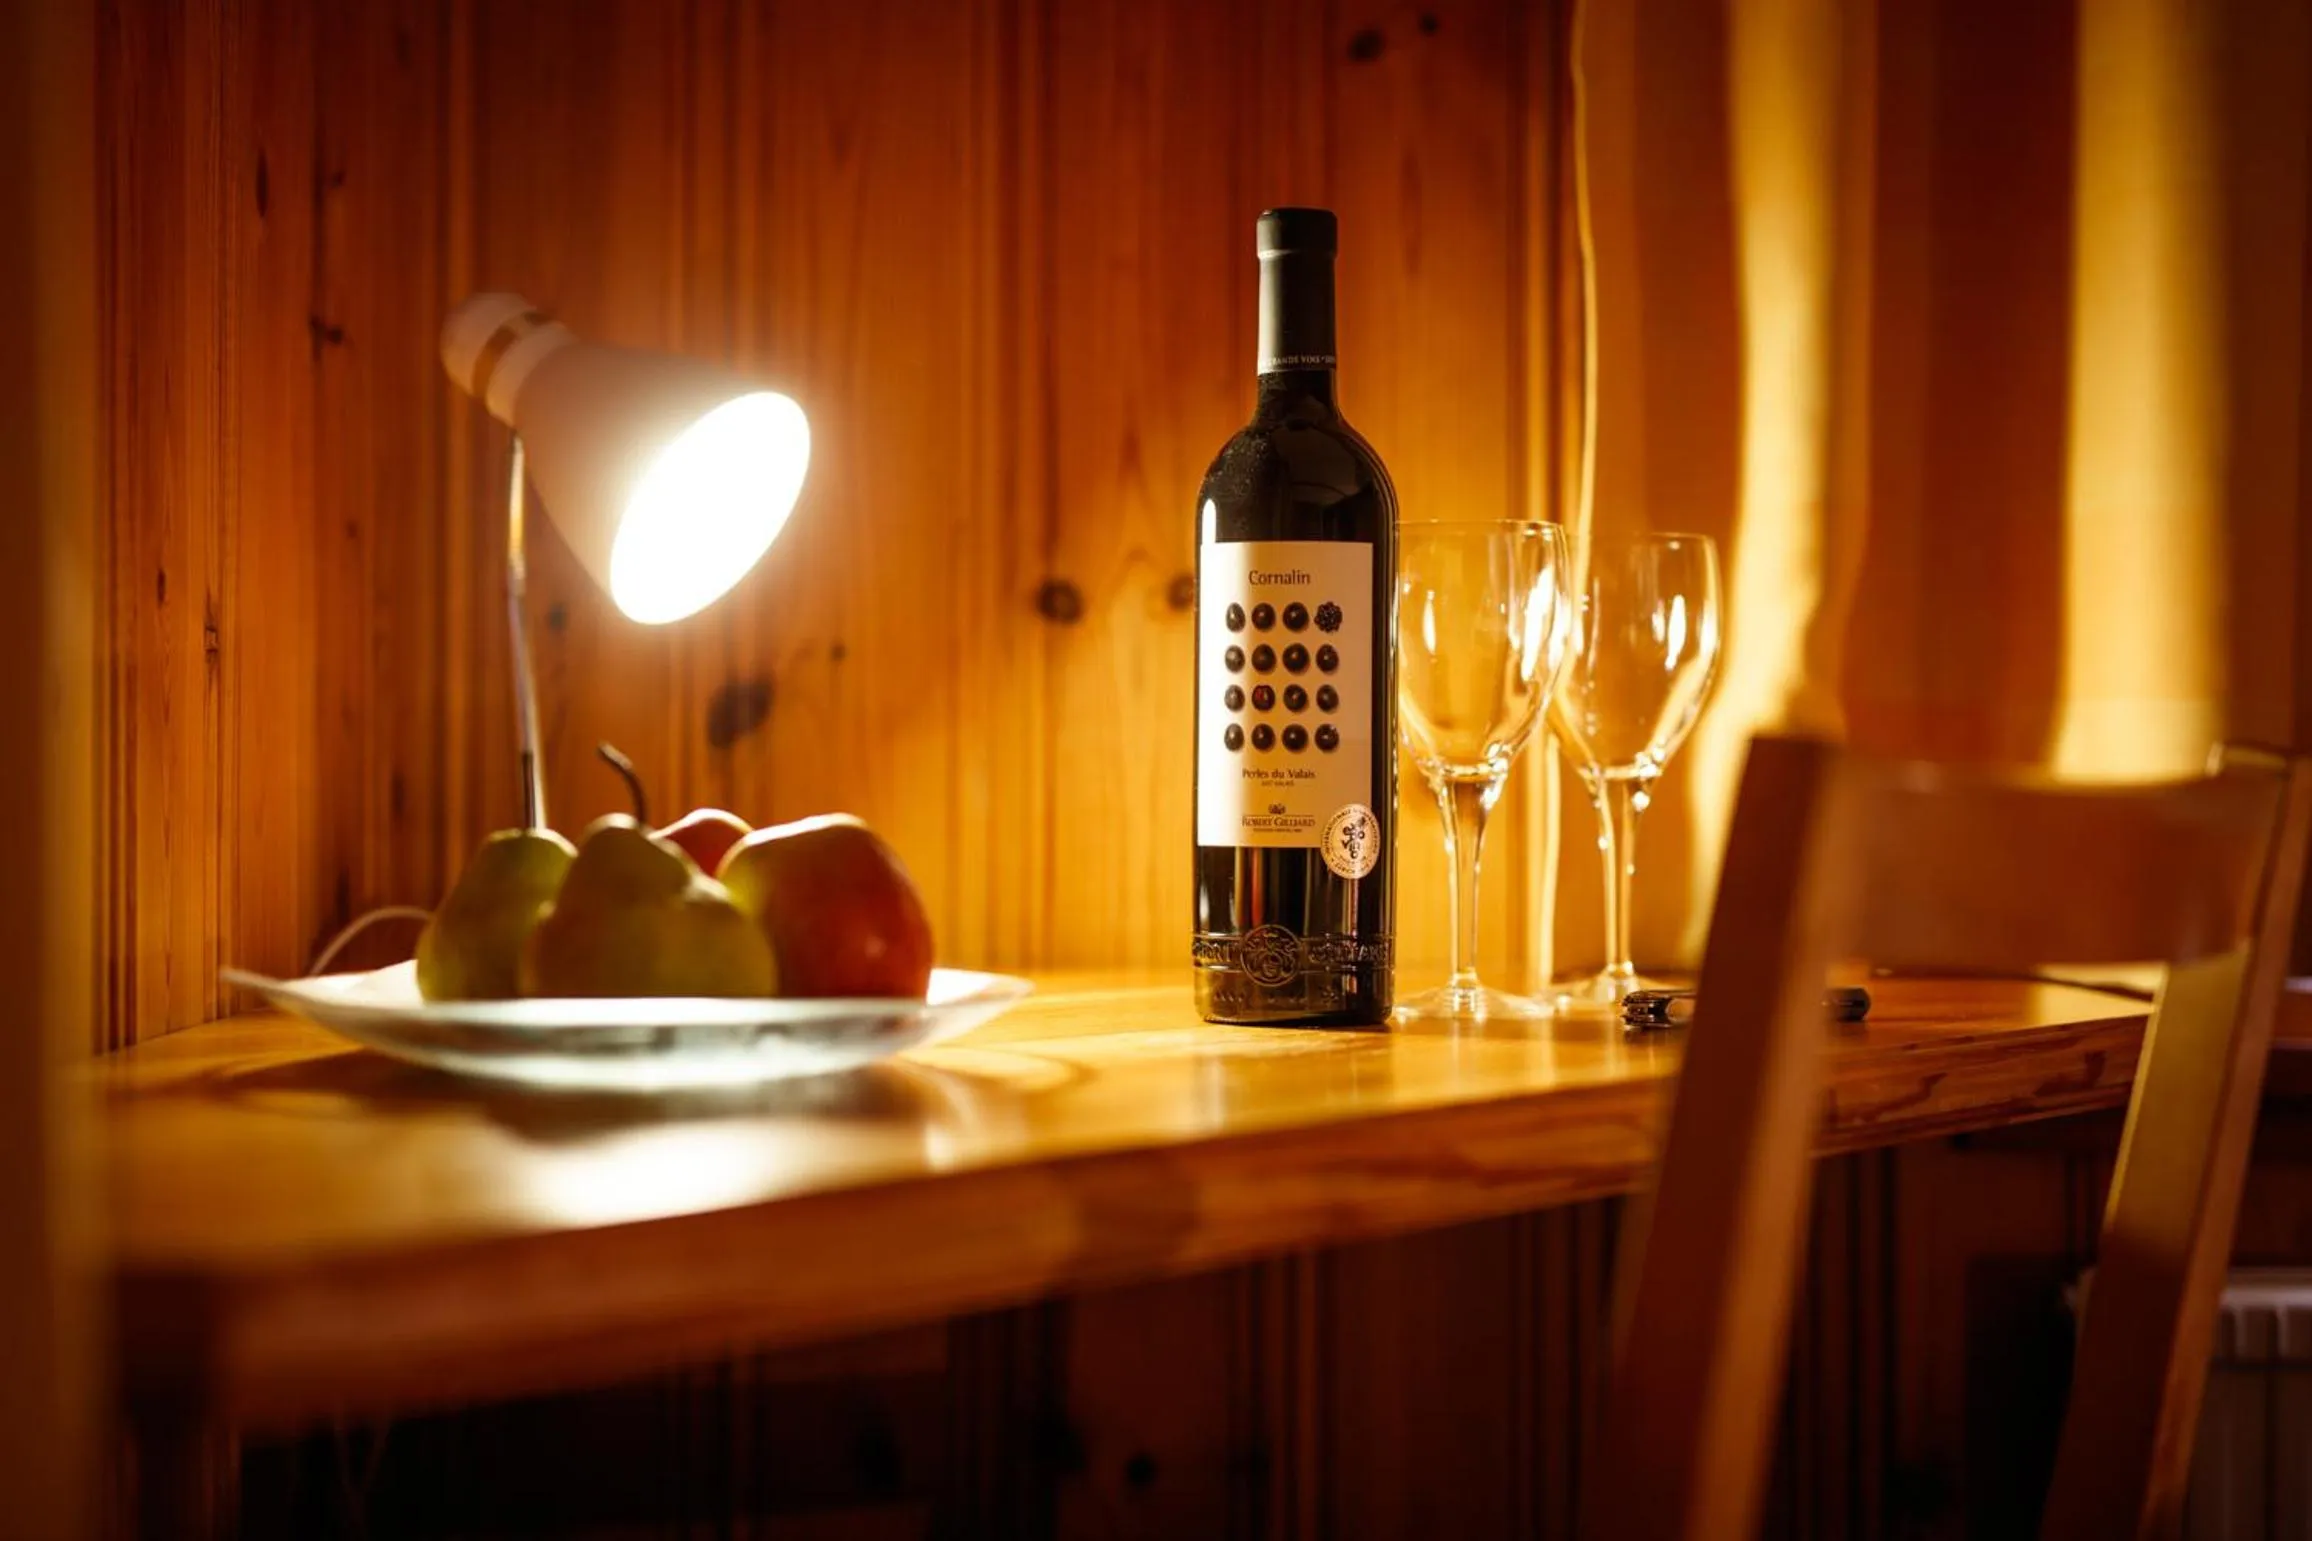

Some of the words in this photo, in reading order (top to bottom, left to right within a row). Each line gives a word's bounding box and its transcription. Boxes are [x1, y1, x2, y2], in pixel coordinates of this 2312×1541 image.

[1248, 569, 1311, 585] Cornalin
[1242, 768, 1269, 779] Perles
[1271, 768, 1285, 778] du
[1287, 768, 1316, 779] Valais
